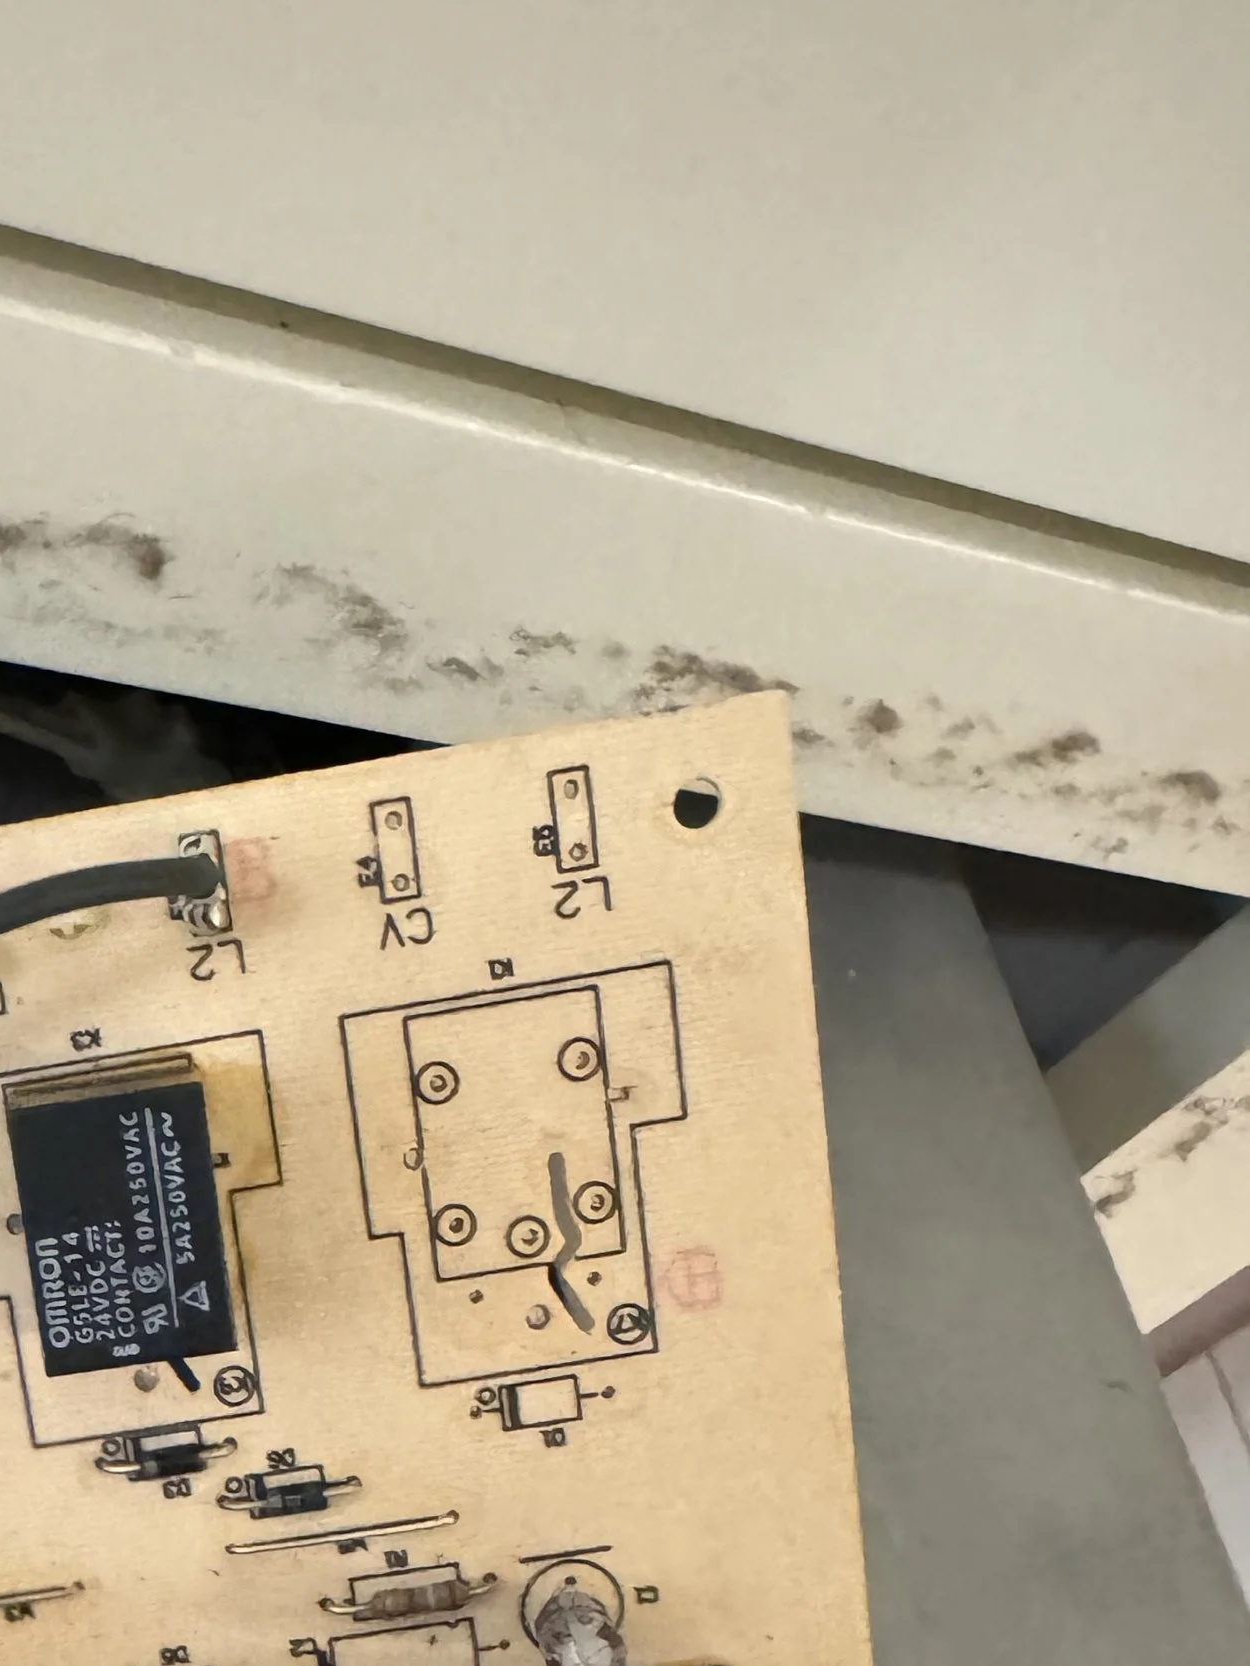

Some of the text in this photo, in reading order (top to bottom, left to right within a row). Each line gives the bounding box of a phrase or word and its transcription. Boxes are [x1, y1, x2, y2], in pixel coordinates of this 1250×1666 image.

[551, 875, 613, 919] L2
[379, 907, 437, 950] CV
[187, 938, 248, 982] L2
